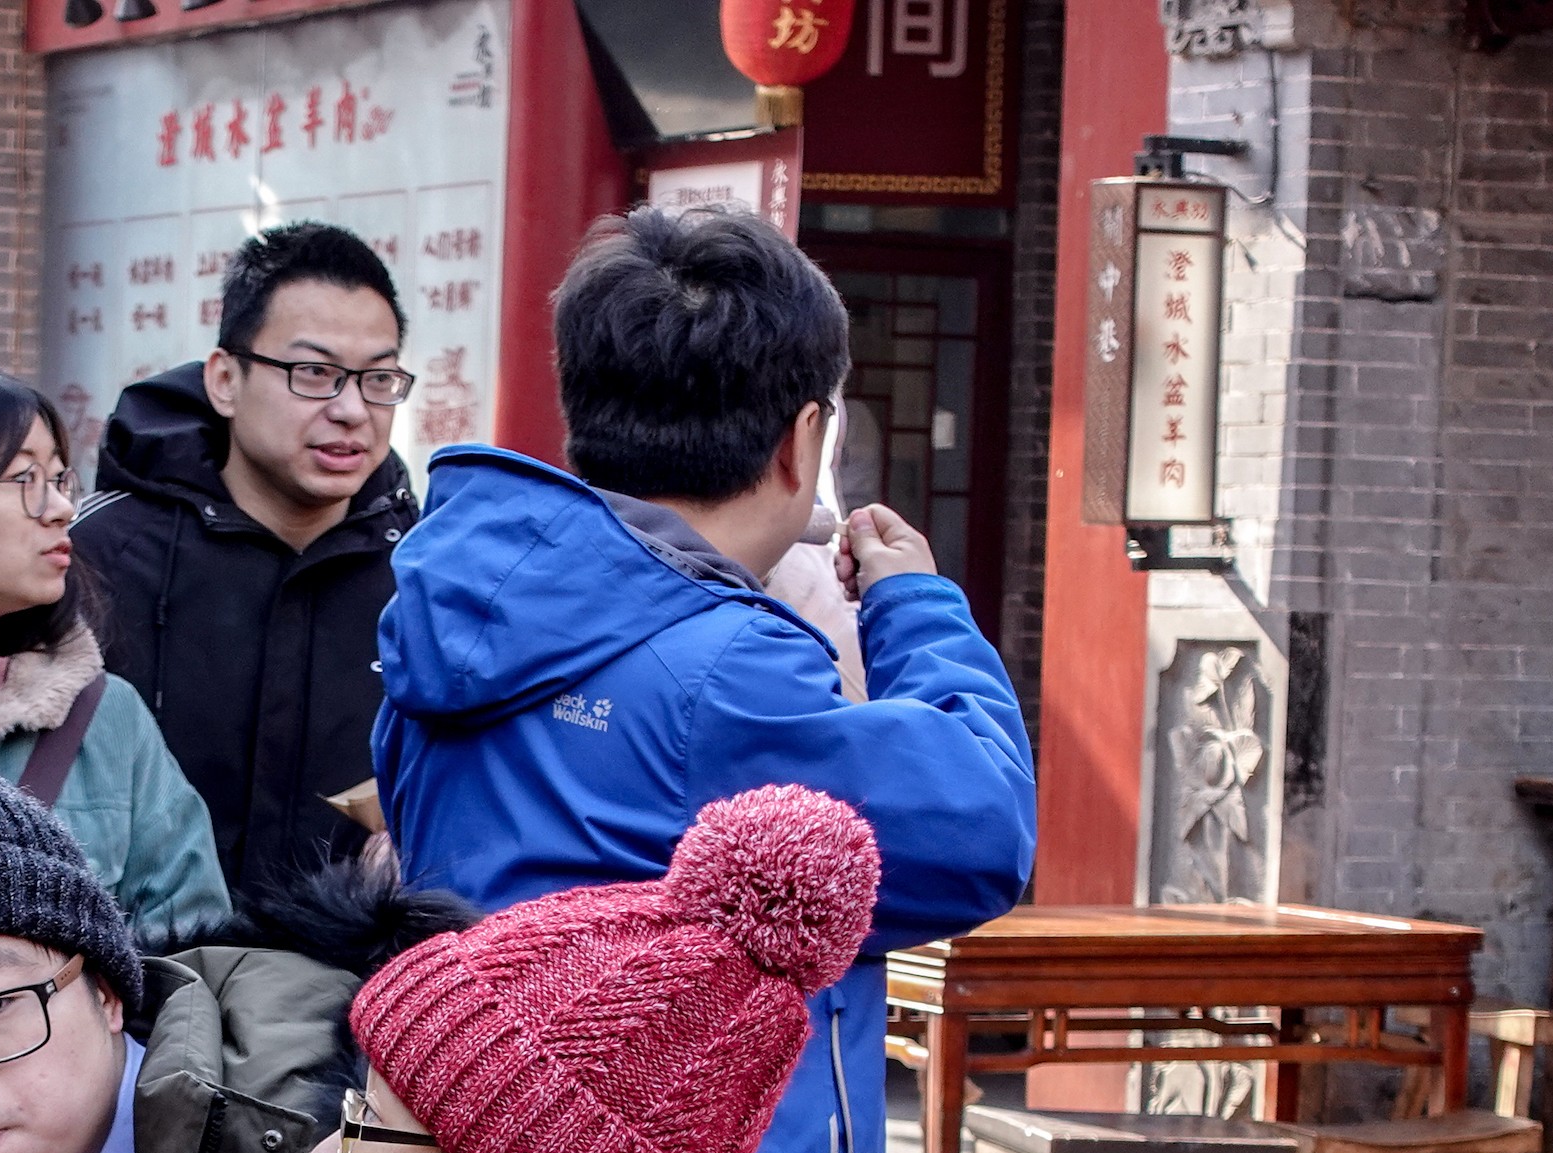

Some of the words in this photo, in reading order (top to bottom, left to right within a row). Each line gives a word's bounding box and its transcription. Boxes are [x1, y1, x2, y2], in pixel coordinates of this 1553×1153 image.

[1159, 248, 1196, 490] 澄城水盆羊肉
[554, 692, 588, 711] Jack
[552, 703, 609, 733] Wolfskin
